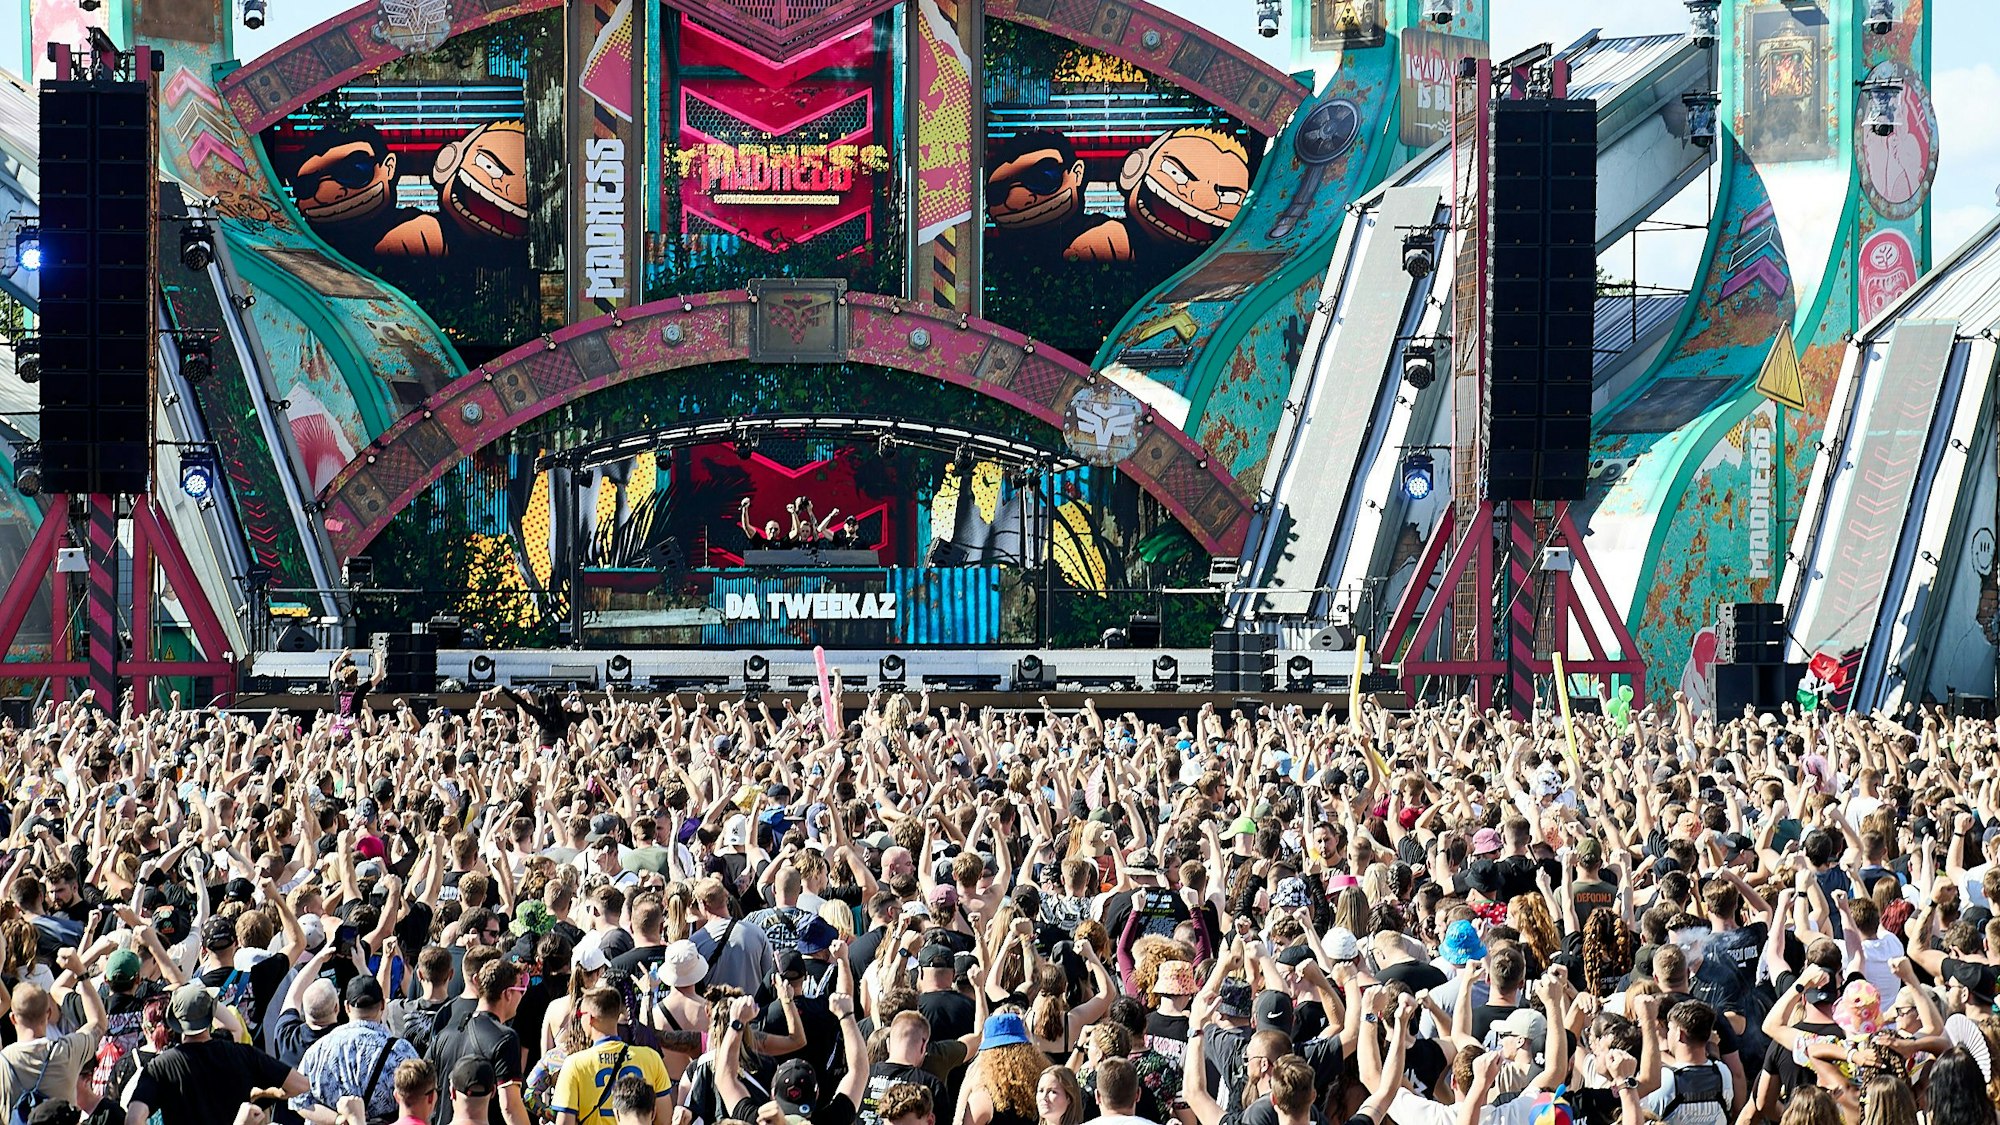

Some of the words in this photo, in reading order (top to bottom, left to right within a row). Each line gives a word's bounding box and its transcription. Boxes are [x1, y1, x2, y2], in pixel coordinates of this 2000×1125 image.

[701, 144, 857, 191] MADNESS
[586, 139, 624, 298] MADNESS
[1750, 428, 1770, 578] MADNESS
[726, 593, 760, 619] DA
[767, 593, 895, 619] TWEEKAZ
[599, 1052, 633, 1065] FRIEE
